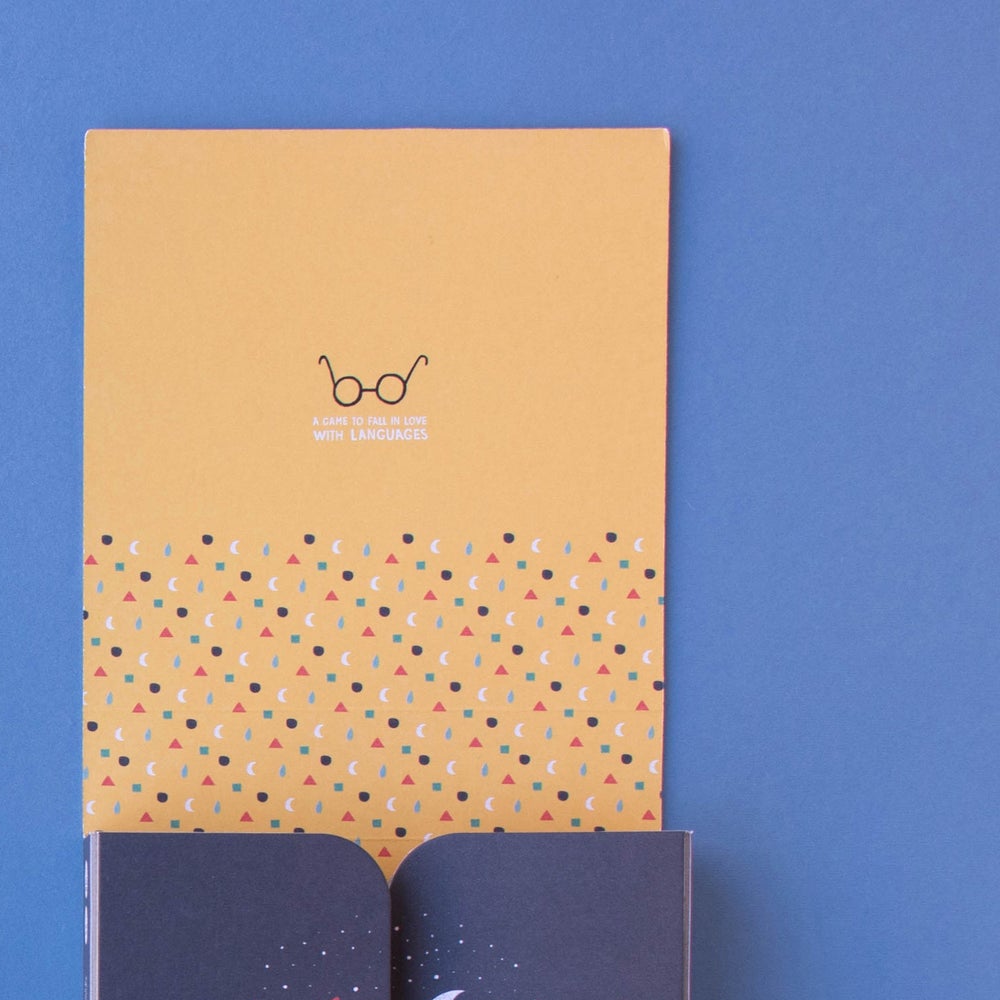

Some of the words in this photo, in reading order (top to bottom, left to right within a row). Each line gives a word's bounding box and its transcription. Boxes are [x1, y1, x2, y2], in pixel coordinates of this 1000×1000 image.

[313, 417, 319, 426] A
[322, 417, 348, 426] GAME
[351, 416, 364, 426] TO
[368, 416, 387, 426] FALL
[391, 416, 400, 426] IN
[404, 416, 427, 425] LOVE
[313, 430, 344, 440] WITH
[350, 429, 428, 440] LANGUAGES
